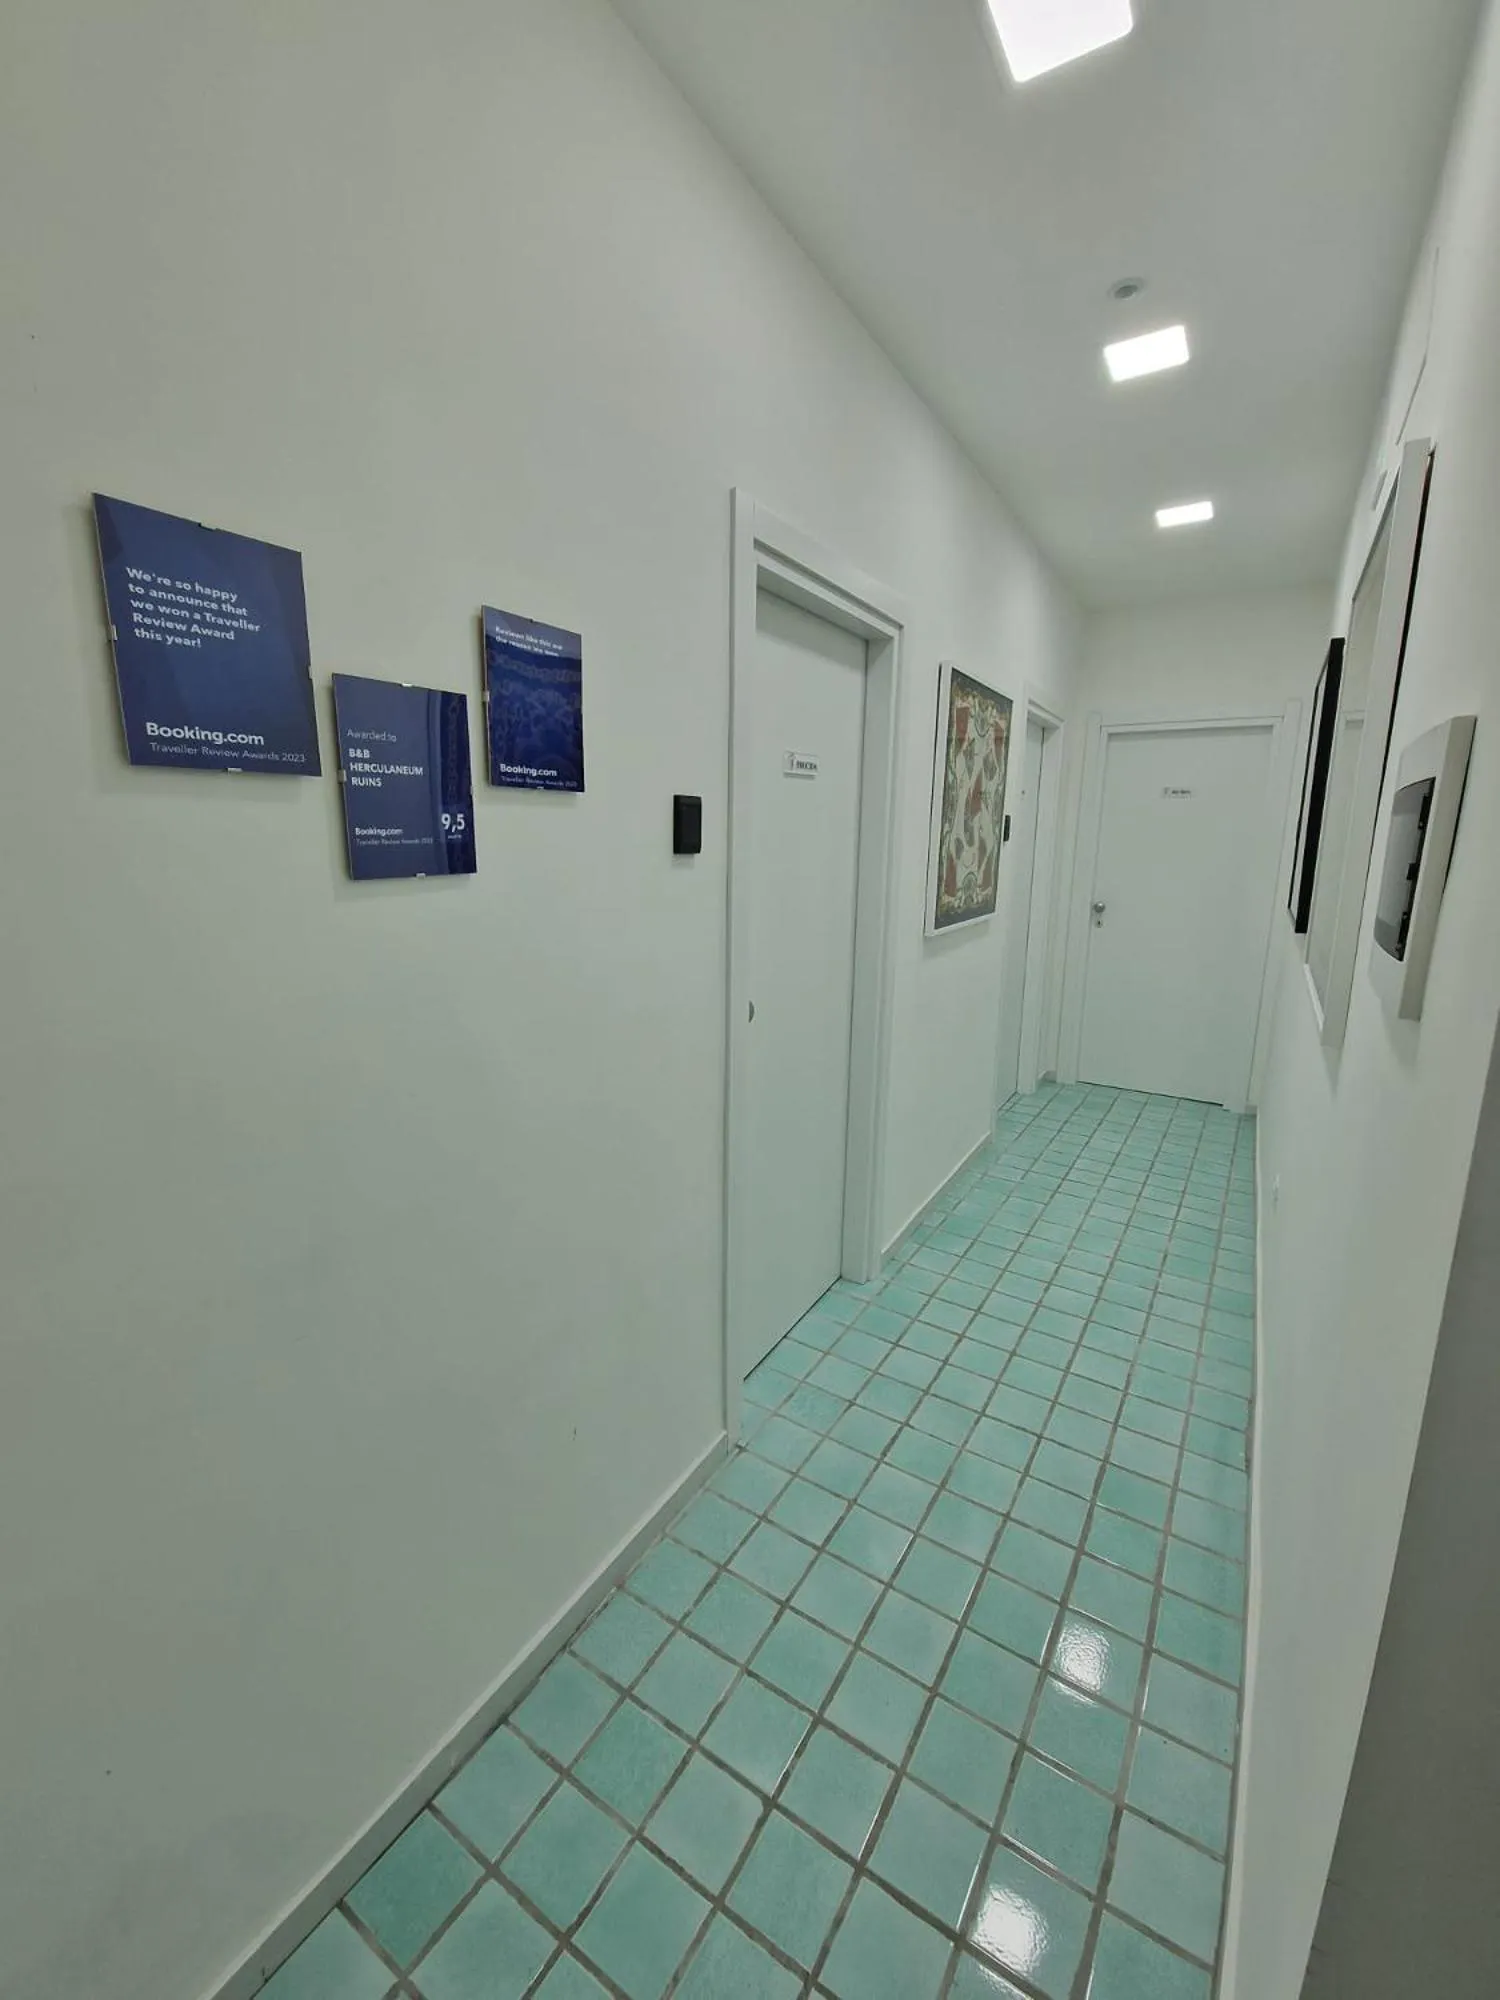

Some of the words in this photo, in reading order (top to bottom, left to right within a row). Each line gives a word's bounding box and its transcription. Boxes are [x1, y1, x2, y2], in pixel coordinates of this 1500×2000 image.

[125, 566, 172, 586] We're
[175, 580, 192, 592] so
[195, 581, 238, 603] happy
[128, 583, 145, 595] to
[148, 589, 219, 610] announce
[220, 603, 248, 617] that
[130, 599, 154, 611] we
[158, 603, 190, 618] won
[193, 612, 201, 620] a
[203, 611, 261, 632] Traveller
[132, 612, 187, 632] Review
[190, 623, 235, 641] Award
[134, 627, 162, 641] this
[166, 635, 201, 648] year!
[145, 721, 265, 746] Booking.com
[347, 728, 386, 741] Awarded
[150, 742, 198, 755] Traveller
[201, 746, 239, 758] Review
[242, 749, 280, 761] Awards
[282, 752, 306, 763] 2023
[348, 748, 370, 758] B&B
[349, 762, 424, 776] HERCULANEUM
[499, 763, 557, 777] Booking.com
[351, 776, 382, 787] RUINS
[355, 827, 403, 837] Booking.com
[441, 812, 465, 833] 9,5
